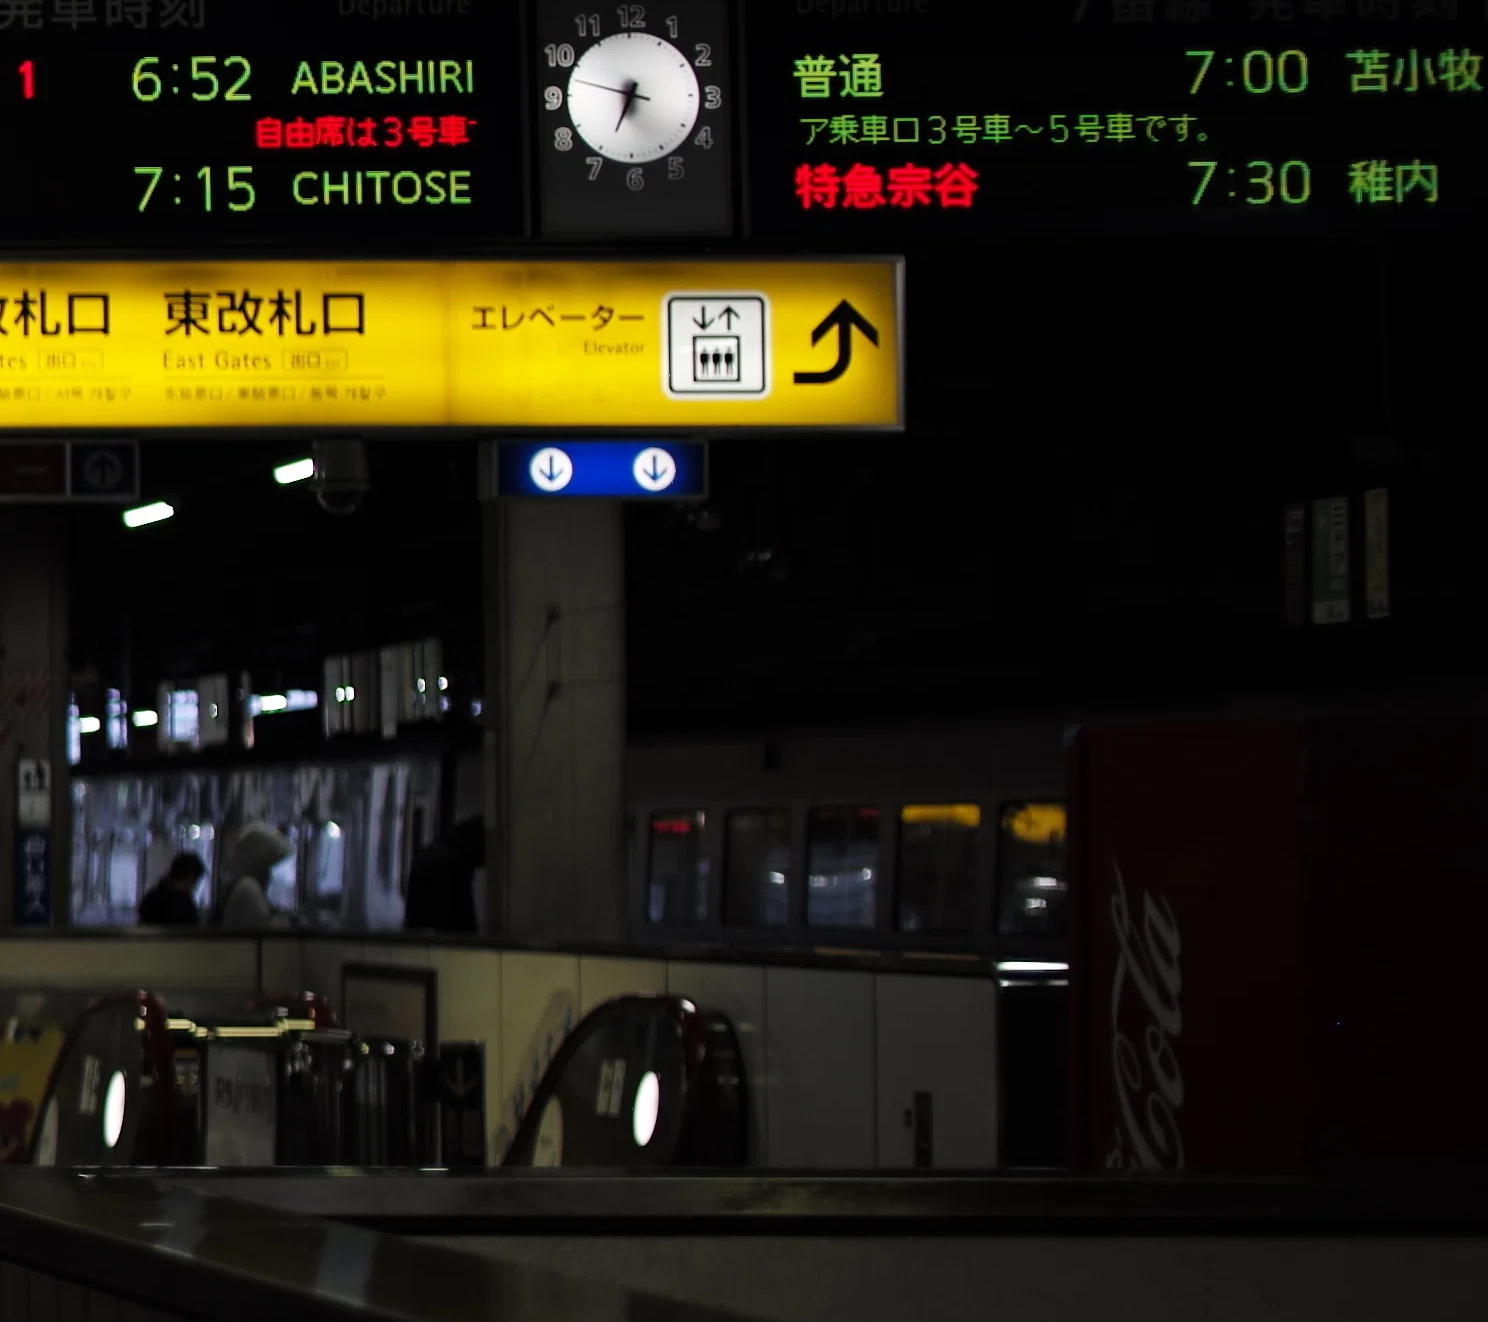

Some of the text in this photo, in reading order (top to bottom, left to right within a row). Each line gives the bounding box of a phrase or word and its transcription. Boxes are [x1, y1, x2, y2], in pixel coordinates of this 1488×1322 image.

[574, 13, 601, 37] 11
[616, 4, 647, 29] 12
[664, 15, 679, 39] 1
[544, 42, 576, 68] 10
[694, 43, 713, 67] 2
[17, 59, 36, 101] 1
[131, 54, 253, 103] 6:52
[289, 58, 475, 96] ABASHIRI
[792, 52, 886, 99] 普通
[1184, 48, 1311, 96] 7:00
[1344, 47, 1485, 95] 苫小牧
[543, 85, 564, 111] 9
[703, 85, 723, 109] 3
[254, 113, 479, 149] 自由席は3号車
[553, 126, 574, 152] 8
[694, 125, 714, 150] 4
[585, 156, 604, 181] 7
[625, 166, 645, 192] 6
[666, 156, 685, 180] 5
[133, 165, 257, 213] 7:15
[291, 170, 473, 206] CHITOSE
[792, 161, 982, 211] 特急宗谷
[1186, 159, 1313, 207] 7:30
[1345, 158, 1440, 207] 稚内
[163, 289, 366, 338] 東改札口
[471, 302, 645, 332] エレベーター
[163, 350, 272, 371] East Gates
[583, 340, 645, 355] Elevator
